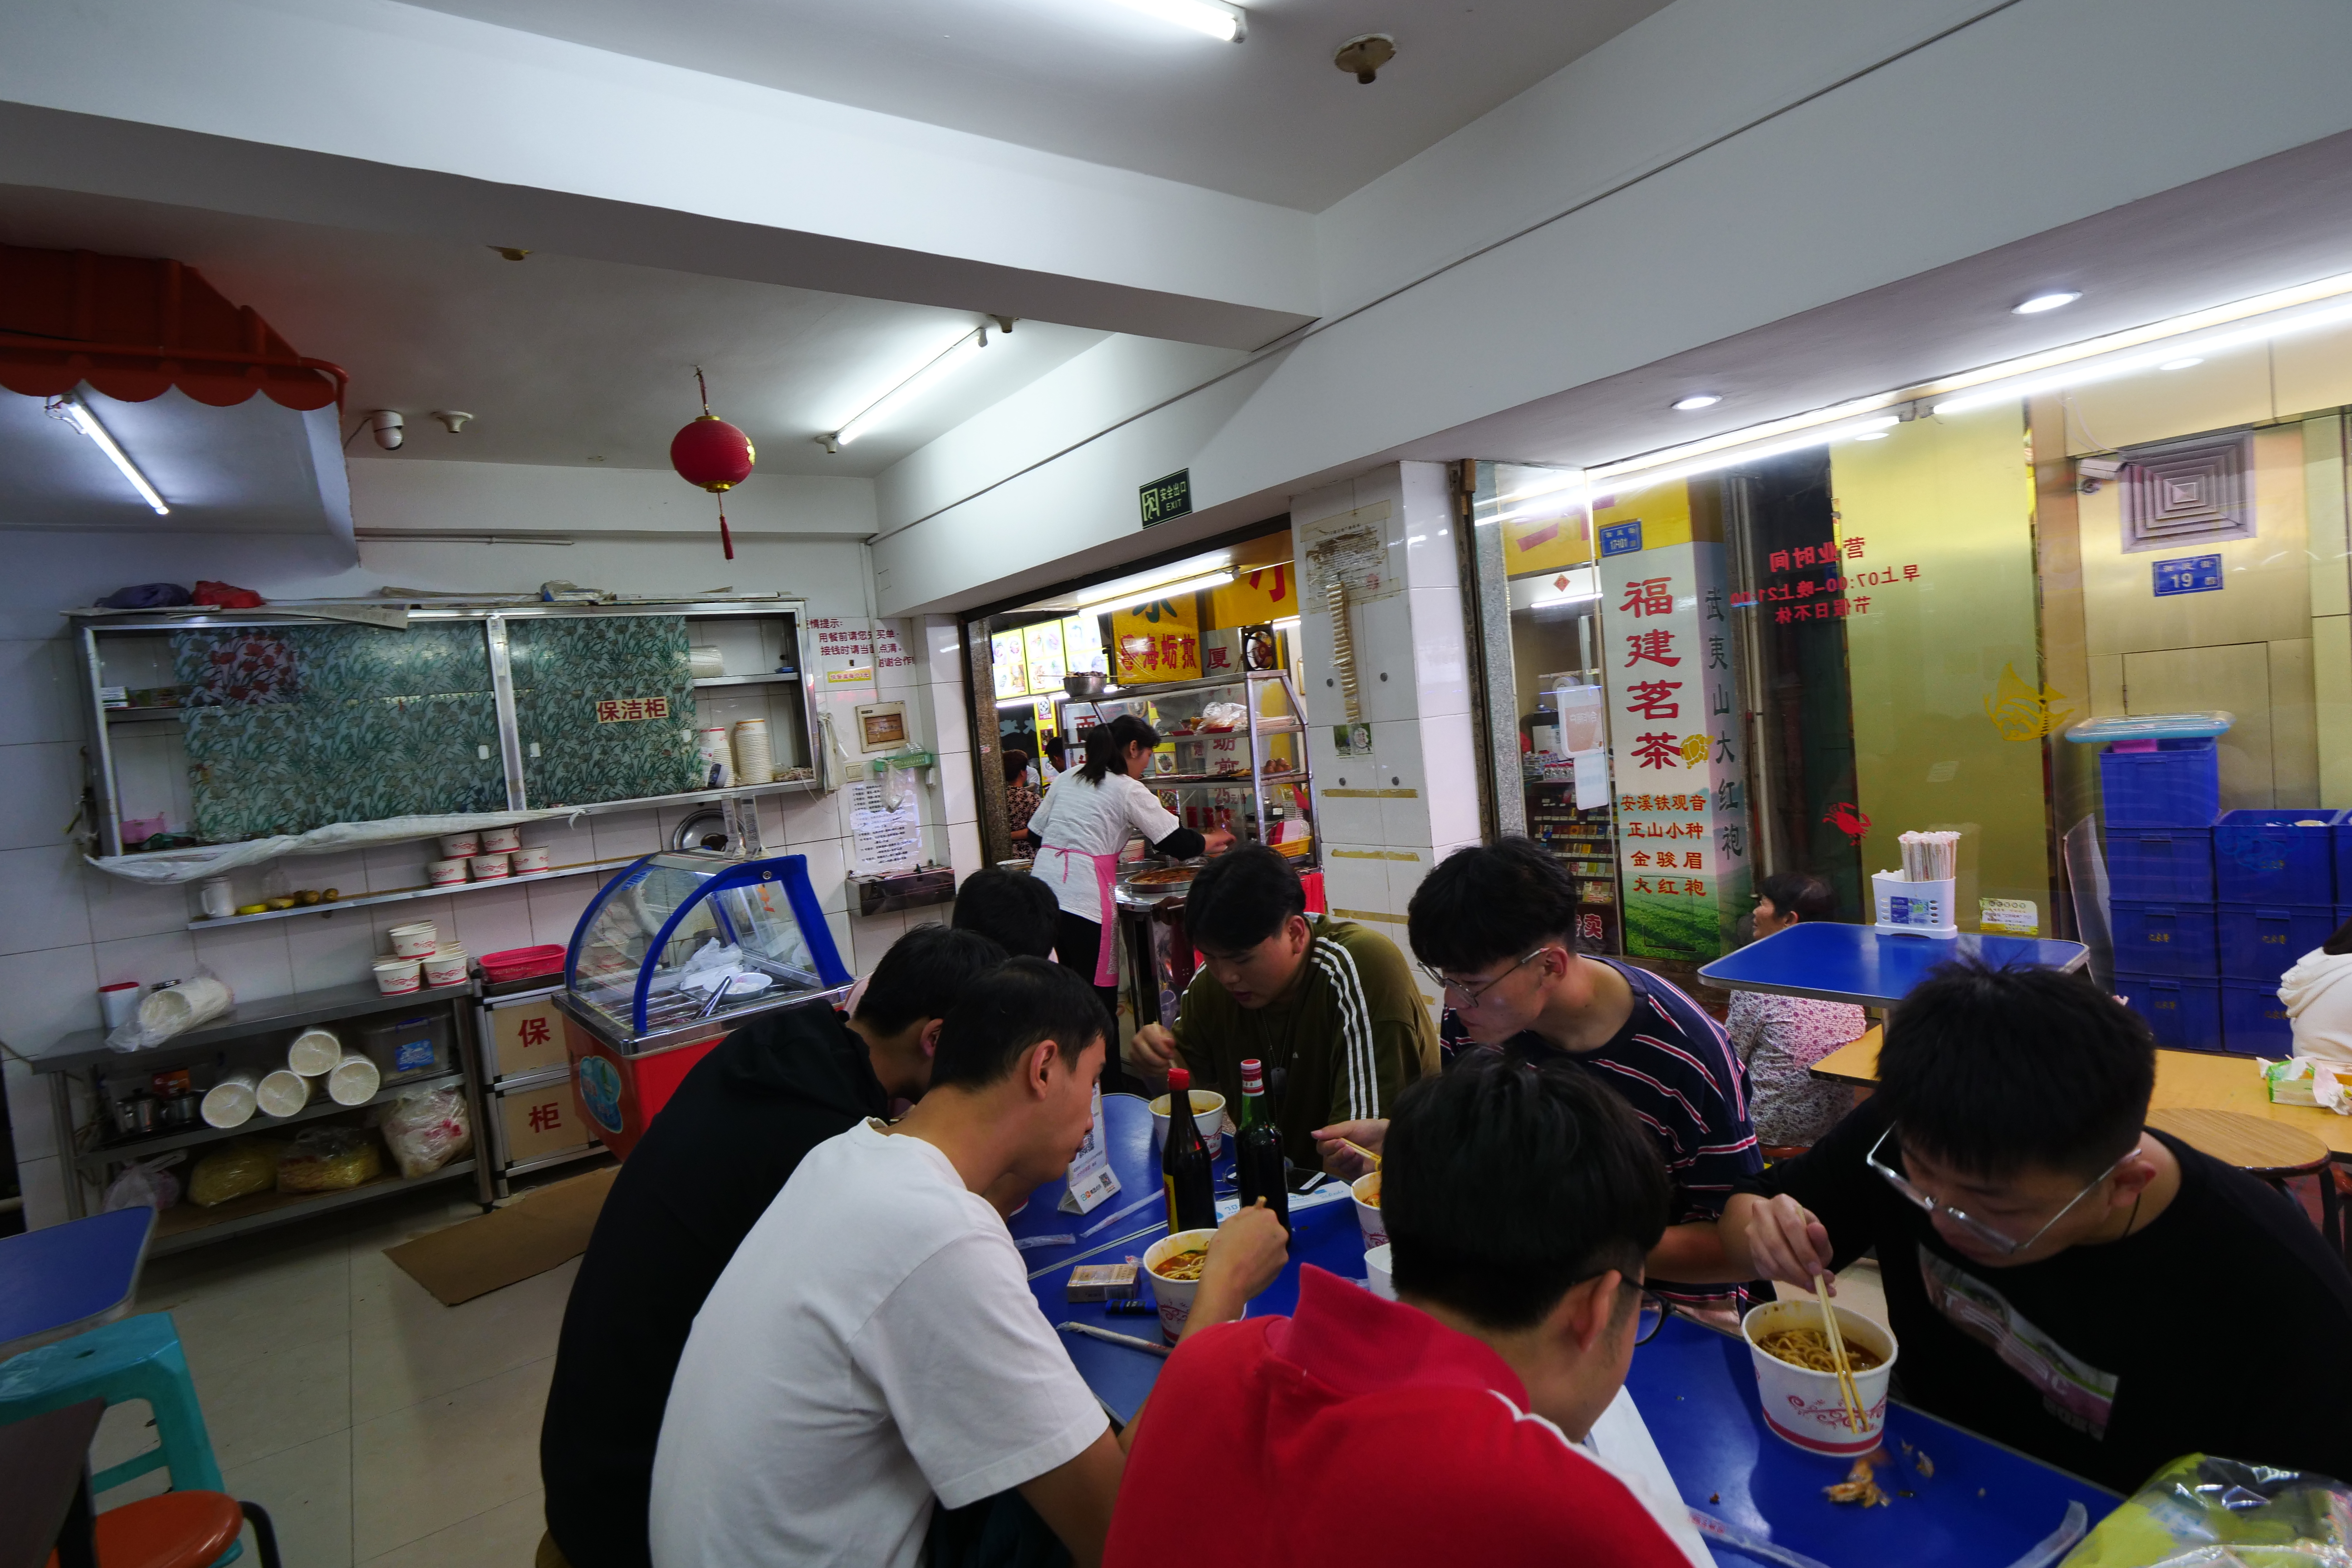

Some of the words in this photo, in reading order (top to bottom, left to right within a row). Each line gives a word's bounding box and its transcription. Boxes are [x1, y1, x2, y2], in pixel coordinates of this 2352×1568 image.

[1160, 481, 1187, 501] 安全出口
[1166, 498, 1182, 511] EXIT
[2171, 573, 2193, 588] 19
[806, 618, 843, 629] 情提示:
[1619, 577, 1683, 770] 福建茗茶
[597, 698, 667, 722] 保洁柜
[1705, 588, 1743, 861] 武夷山大红袍
[1620, 794, 1707, 812] 安溪铁观音
[1627, 822, 1703, 840] 正山小种
[1630, 850, 1702, 870] 金骏眉
[1632, 877, 1707, 897] 大红袍
[518, 1017, 551, 1048] 保
[528, 1102, 562, 1133] 柜
